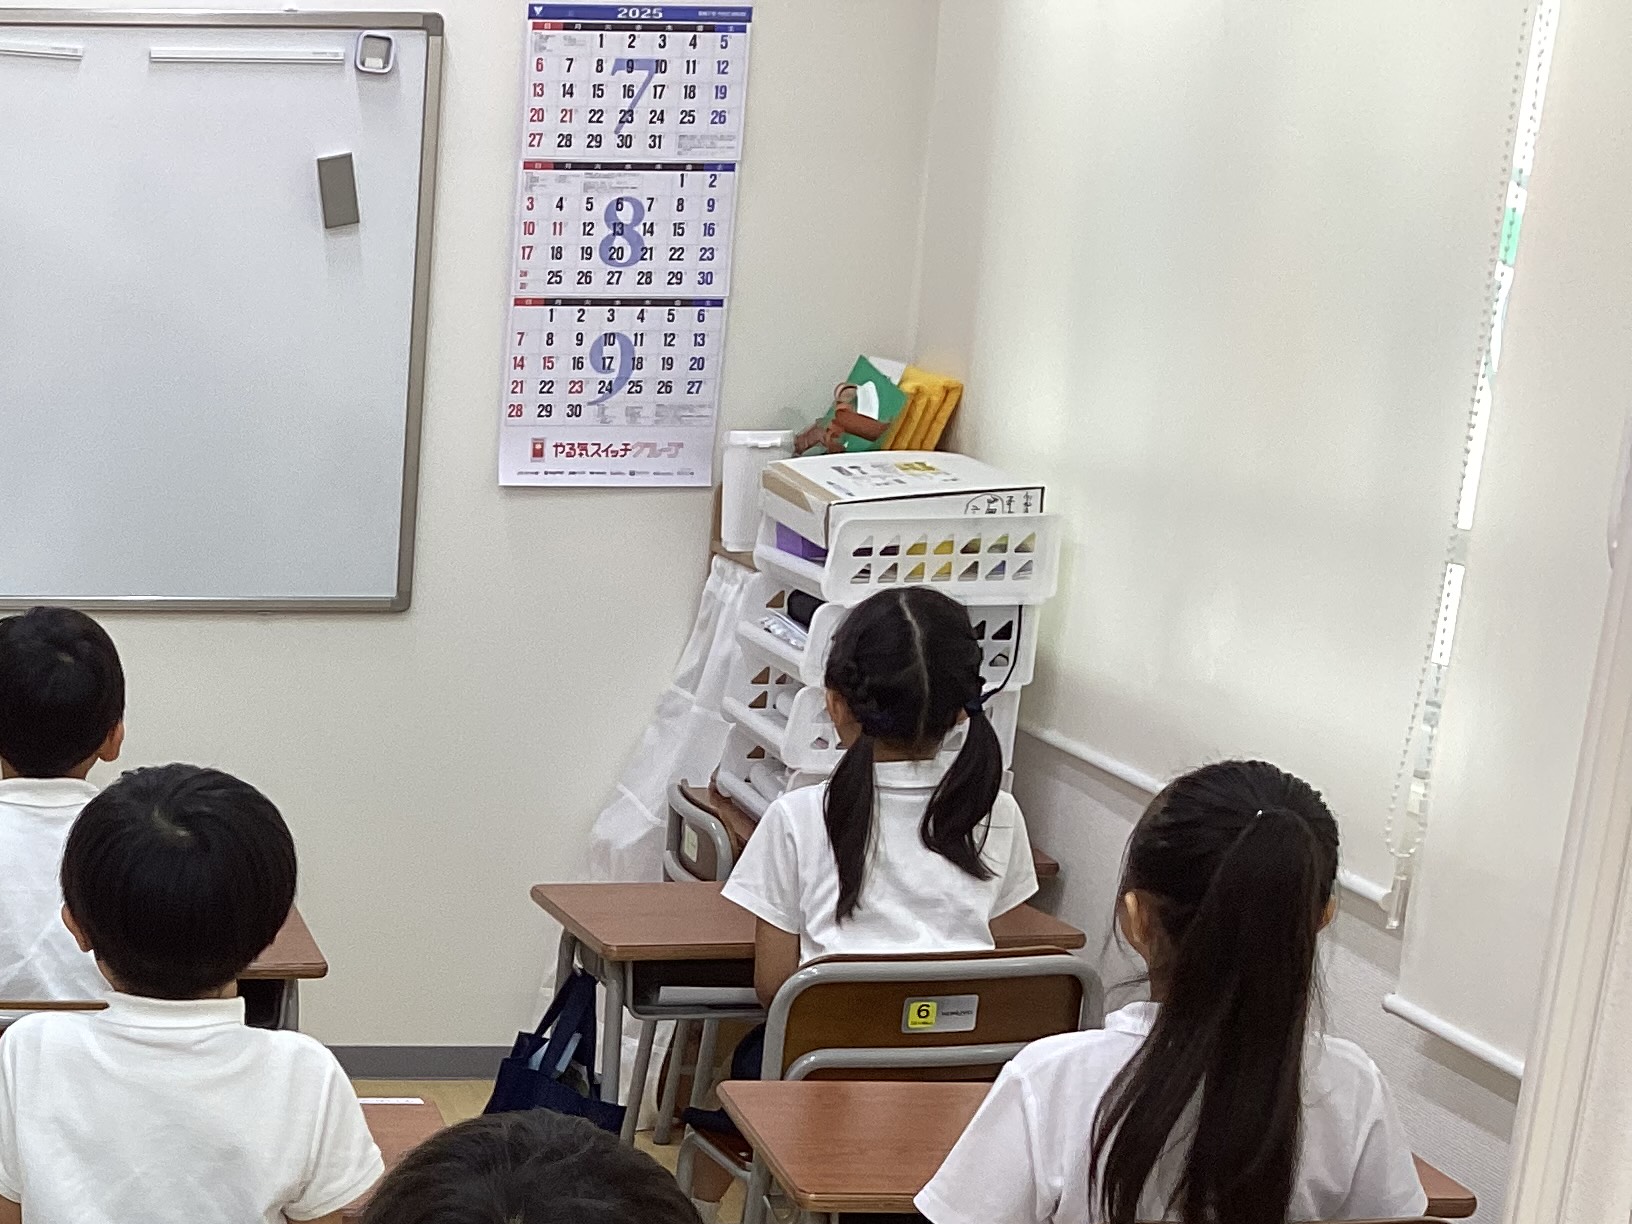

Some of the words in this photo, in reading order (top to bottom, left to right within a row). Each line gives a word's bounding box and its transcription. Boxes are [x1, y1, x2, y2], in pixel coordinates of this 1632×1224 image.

[617, 7, 664, 19] 2025
[598, 34, 604, 48] 1
[628, 34, 635, 49] 2
[658, 34, 666, 49] 3
[689, 34, 697, 49] 4
[720, 35, 728, 49] 5
[536, 58, 543, 72] 6
[566, 58, 573, 73] 7
[596, 59, 603, 73] 8
[626, 59, 634, 73] 9
[654, 59, 667, 74] 10
[686, 60, 696, 74] 11
[717, 60, 729, 74] 12
[533, 83, 544, 97] 13
[562, 83, 574, 98] 14
[592, 84, 604, 98] 15
[622, 84, 634, 98] 16
[653, 85, 665, 99] 17
[684, 85, 696, 99] 18
[714, 85, 727, 99] 19
[611, 58, 662, 134] 7
[530, 108, 544, 122] 20
[560, 109, 573, 123] 21
[588, 109, 604, 123] 22
[619, 109, 634, 123] 23
[649, 110, 664, 124] 24
[680, 110, 695, 124] 25
[710, 110, 726, 124] 26
[528, 133, 543, 147] 27
[557, 133, 572, 148] 28
[587, 134, 602, 148] 29
[617, 134, 632, 148] 30
[648, 135, 662, 149] 31
[680, 174, 684, 187] 1
[709, 174, 717, 188] 2
[526, 197, 534, 211] 3
[556, 197, 563, 211] 4
[586, 198, 593, 211] 5
[616, 198, 623, 211] 6
[647, 198, 654, 212] 7
[677, 198, 684, 212] 8
[707, 198, 715, 212] 9
[523, 222, 535, 236] 10
[553, 222, 562, 236] 11
[583, 222, 594, 236] 12
[612, 222, 624, 236] 13
[643, 222, 654, 236] 14
[673, 223, 684, 236] 15
[703, 223, 715, 236] 16
[599, 196, 645, 267] 8
[522, 246, 533, 260] 17
[551, 246, 562, 260] 18
[581, 247, 592, 260] 19
[609, 247, 624, 260] 20
[640, 247, 653, 261] 21
[669, 247, 684, 261] 22
[699, 247, 714, 261] 23
[547, 271, 562, 285] 25
[577, 271, 592, 285] 26
[607, 271, 621, 285] 27
[637, 272, 652, 285] 28
[667, 272, 682, 285] 29
[698, 272, 713, 285] 30
[549, 308, 553, 322] 1
[577, 309, 585, 322] 2
[607, 309, 615, 322] 3
[637, 309, 645, 323] 4
[667, 309, 675, 322] 5
[697, 309, 705, 323] 6
[517, 332, 524, 345] 7
[546, 333, 553, 346] 8
[575, 333, 583, 346] 9
[604, 333, 615, 346] 10
[634, 333, 643, 346] 11
[663, 333, 675, 346] 12
[693, 333, 705, 346] 13
[513, 356, 525, 370] 14
[543, 356, 554, 370] 15
[572, 357, 584, 370] 16
[602, 357, 614, 370] 17
[632, 357, 643, 370] 18
[661, 357, 673, 371] 19
[689, 357, 705, 371] 20
[587, 332, 635, 406] 9
[511, 380, 523, 394] 21
[539, 380, 554, 394] 22
[568, 380, 583, 394] 23
[598, 381, 613, 394] 24
[627, 381, 643, 394] 25
[657, 381, 672, 394] 26
[687, 381, 702, 394] 27
[508, 404, 523, 417] 28
[537, 404, 552, 417] 29
[566, 405, 581, 417] 30
[917, 1004, 930, 1019] 6
